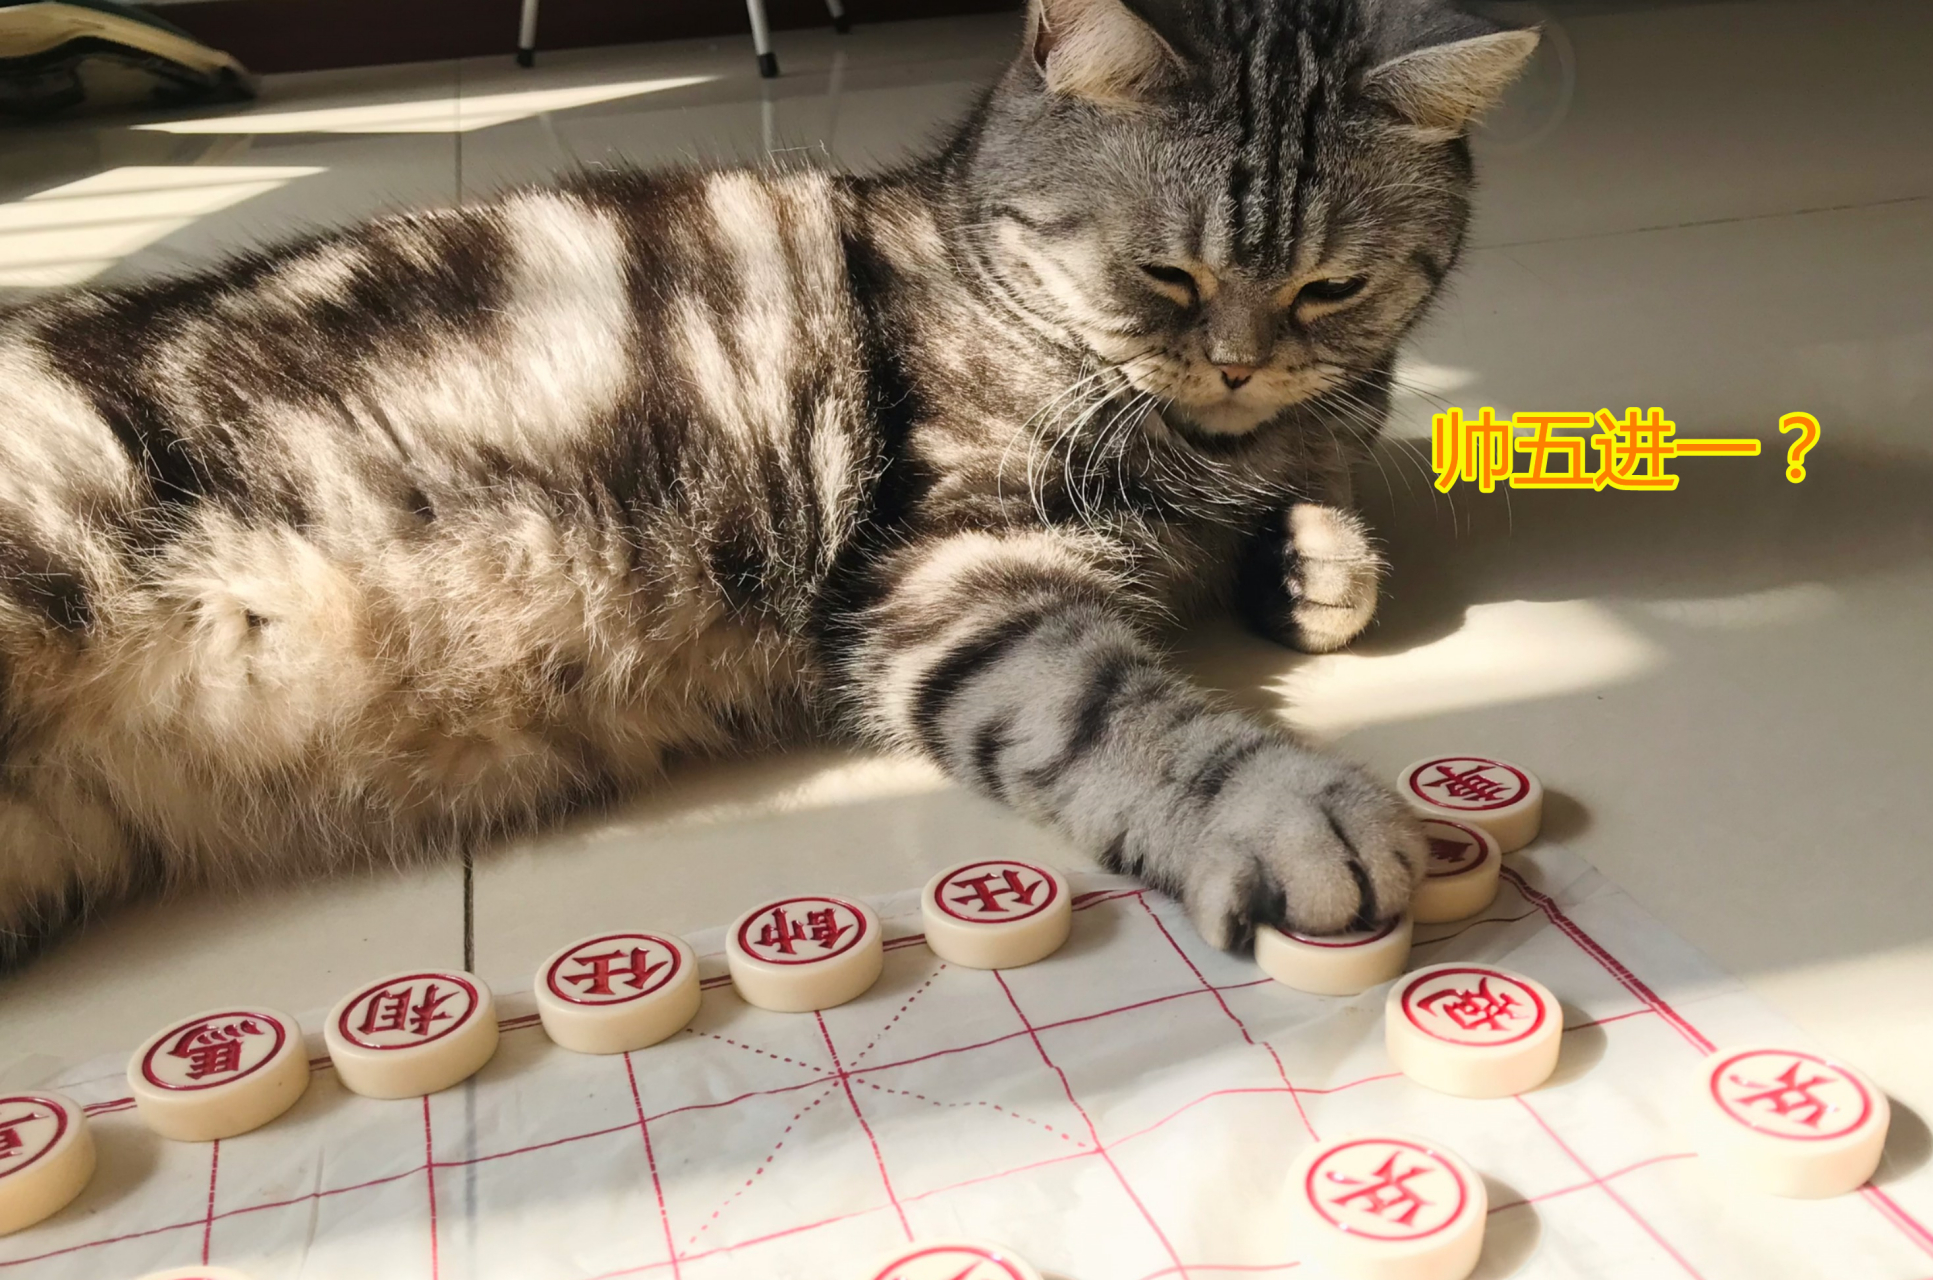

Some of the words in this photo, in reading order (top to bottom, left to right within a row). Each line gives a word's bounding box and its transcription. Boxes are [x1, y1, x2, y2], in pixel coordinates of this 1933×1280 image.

[1422, 765, 1512, 802] 車
[952, 868, 1045, 914] 仕
[755, 907, 854, 956] 帥
[563, 947, 668, 996] 仕
[357, 983, 460, 1036] 相
[1416, 976, 1531, 1032] 炮
[169, 1020, 263, 1080] 馬
[1728, 1060, 1840, 1130] 兵
[1326, 1150, 1433, 1228] 兵
